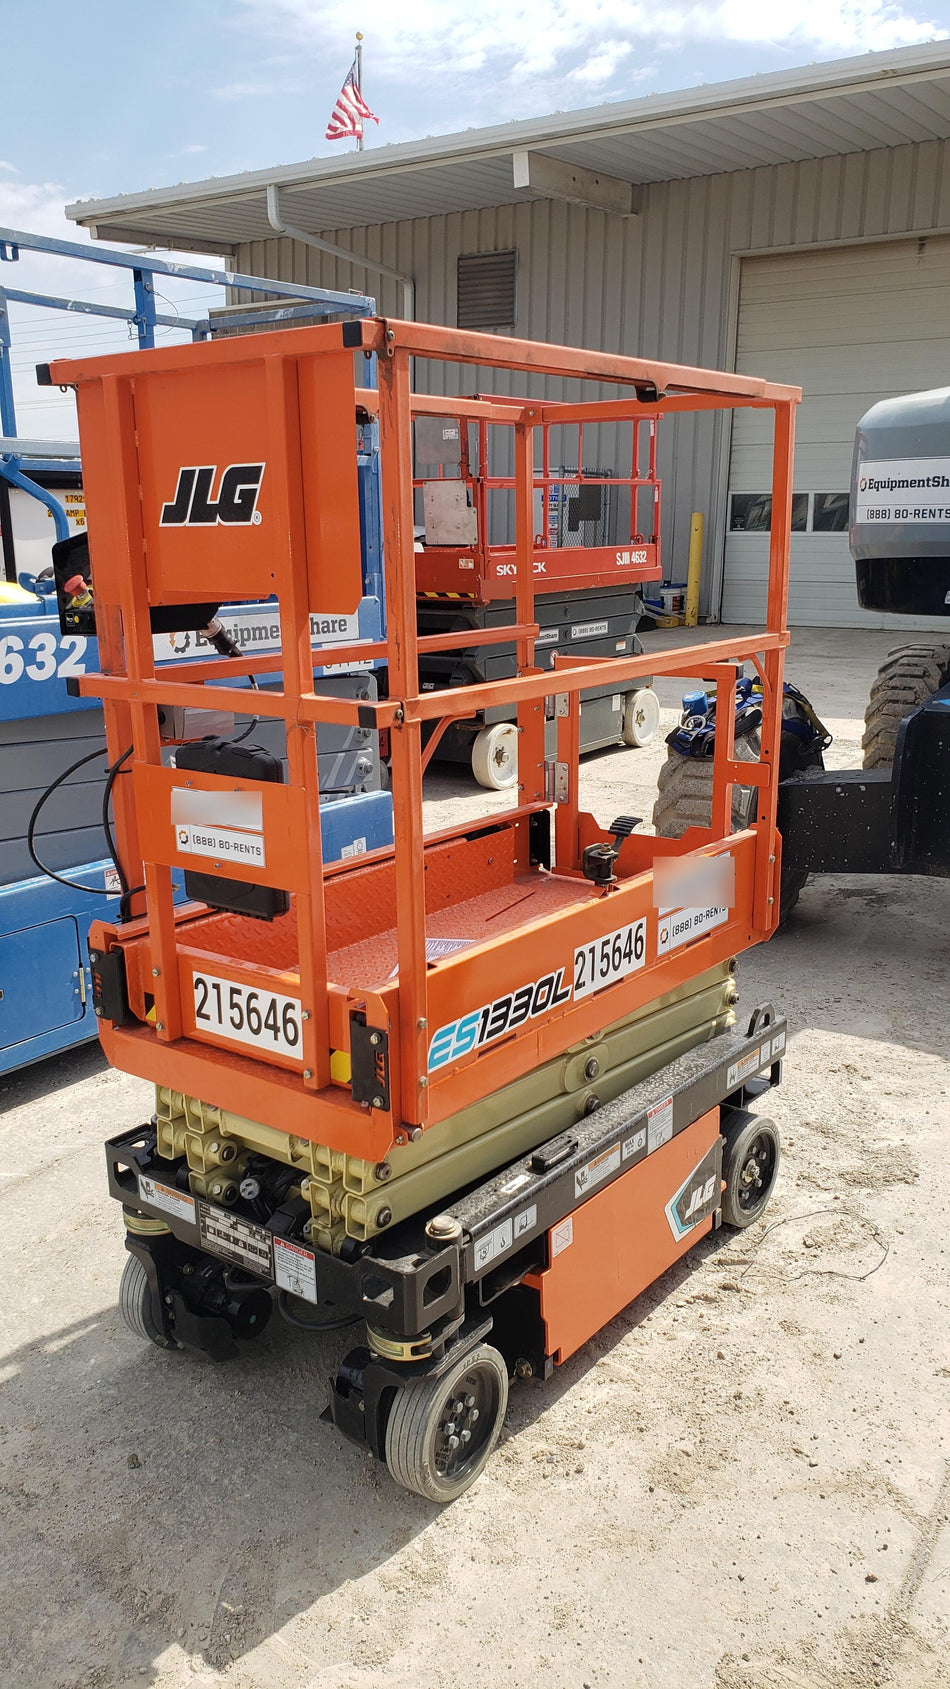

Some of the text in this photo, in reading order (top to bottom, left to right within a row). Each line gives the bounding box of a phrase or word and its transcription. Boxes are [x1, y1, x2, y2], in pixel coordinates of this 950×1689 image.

[160, 464, 264, 525] JLG
[867, 508, 891, 519] (888)
[631, 550, 647, 564] 4632
[193, 834, 262, 856] (888) 80-RENTS
[672, 917, 692, 937] (888)
[574, 922, 644, 992] 215646
[194, 977, 299, 1047] 215646
[428, 972, 572, 1070] ES1330L
[684, 1173, 717, 1220] JLG
